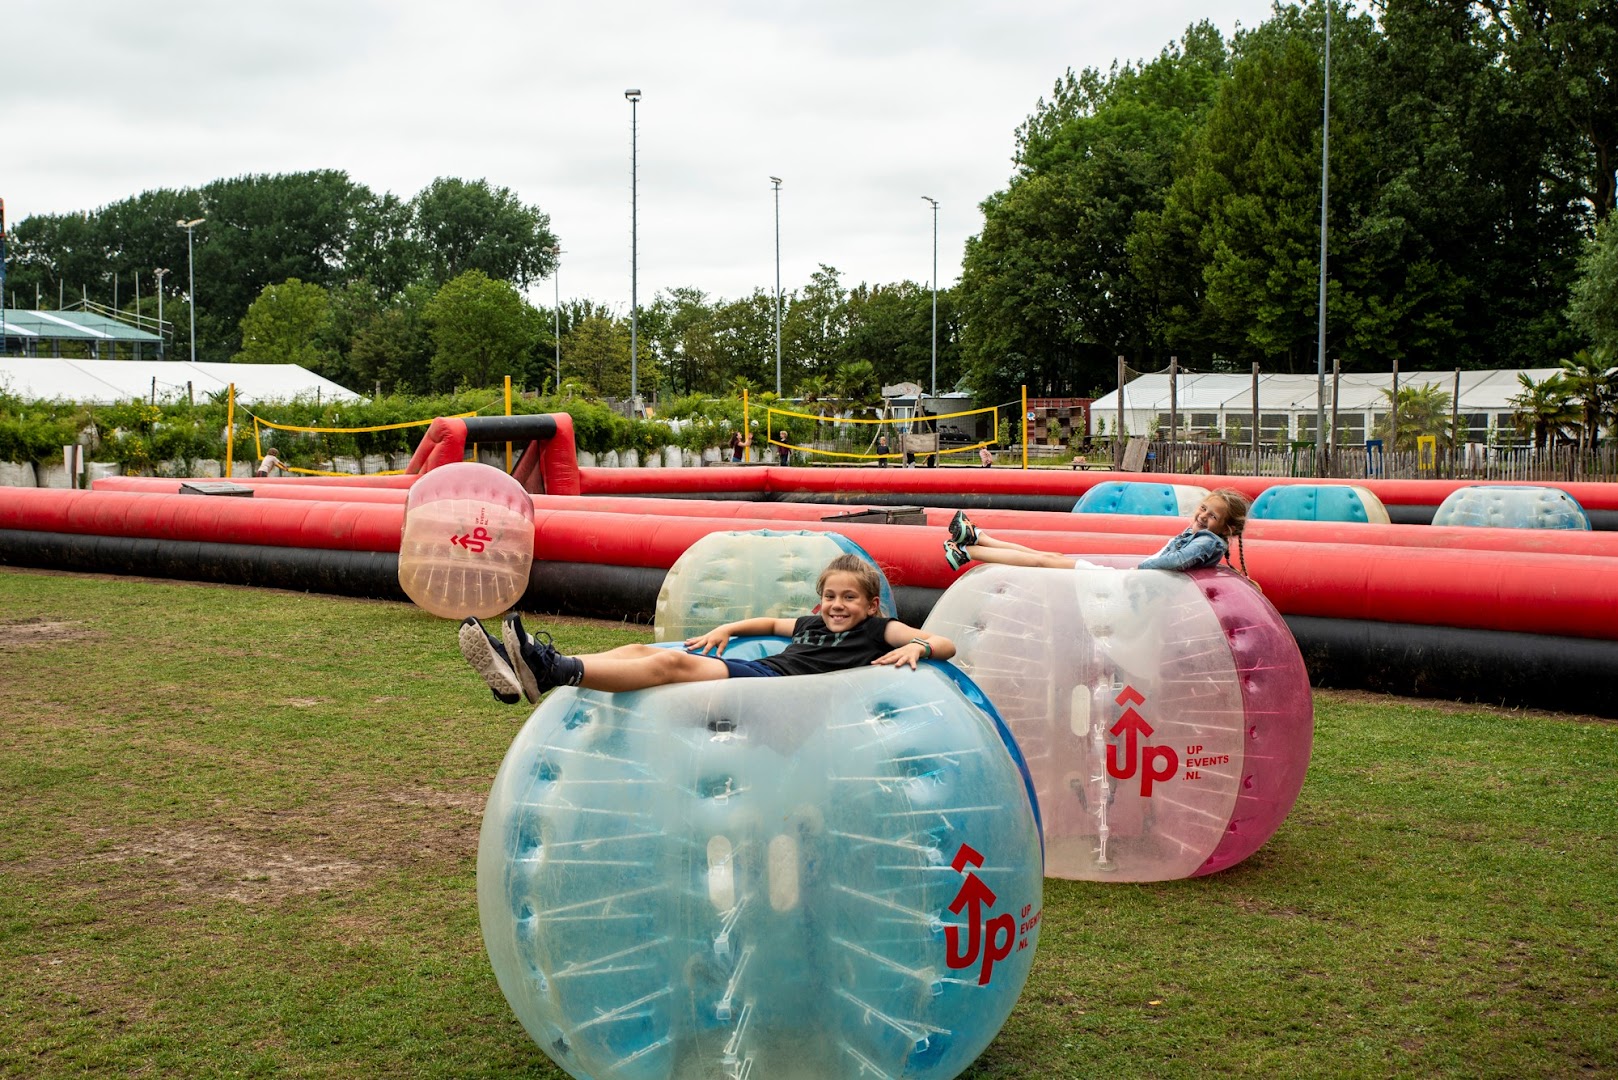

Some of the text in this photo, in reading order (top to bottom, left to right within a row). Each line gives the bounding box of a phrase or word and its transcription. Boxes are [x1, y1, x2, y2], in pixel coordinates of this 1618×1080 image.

[1187, 745, 1203, 755] UP
[1186, 755, 1229, 768] EVENTS
[1021, 904, 1031, 918] UP
